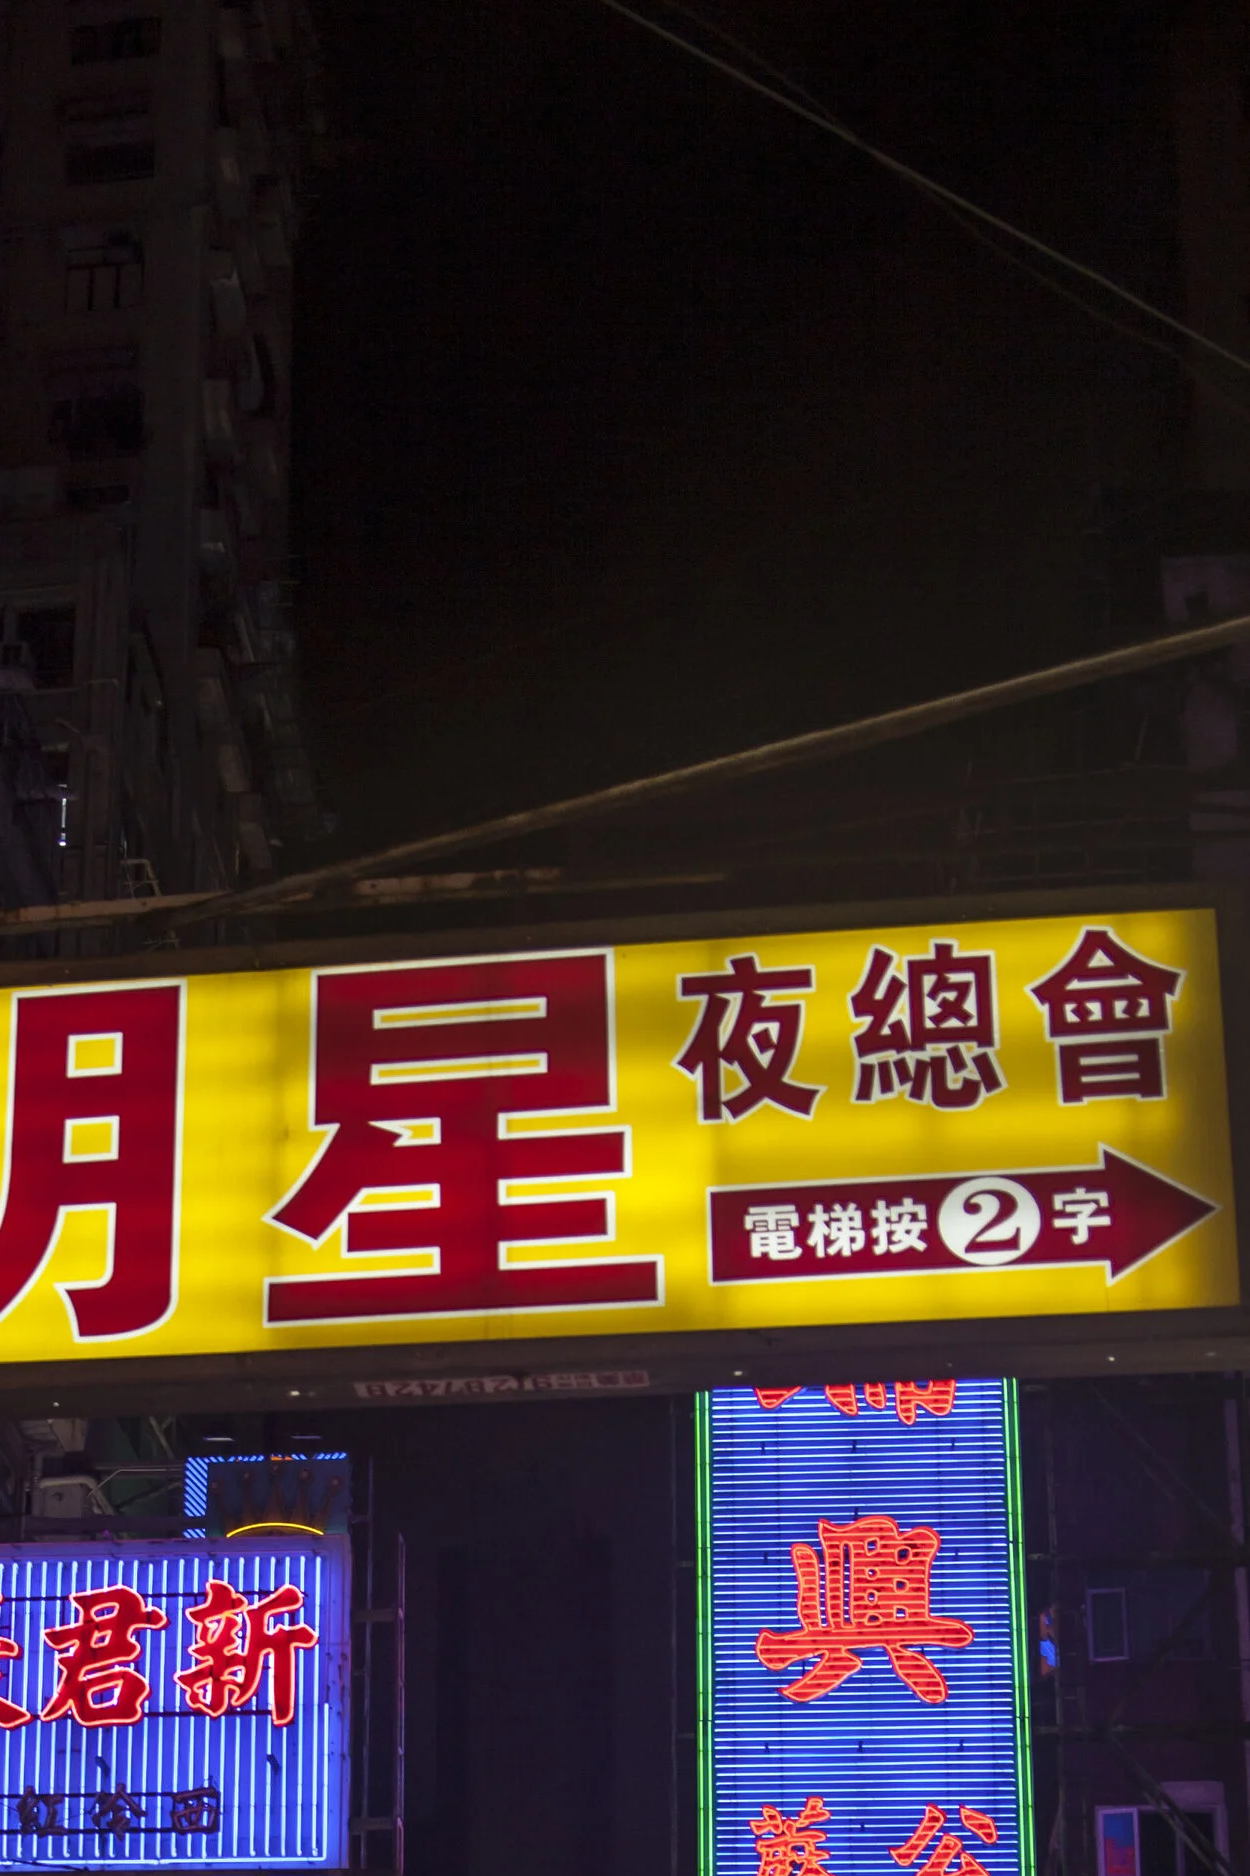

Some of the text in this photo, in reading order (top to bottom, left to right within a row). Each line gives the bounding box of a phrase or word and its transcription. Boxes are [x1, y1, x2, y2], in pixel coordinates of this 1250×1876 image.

[675, 925, 1187, 1122] 夜總會
[754, 1386, 975, 1704] 興
